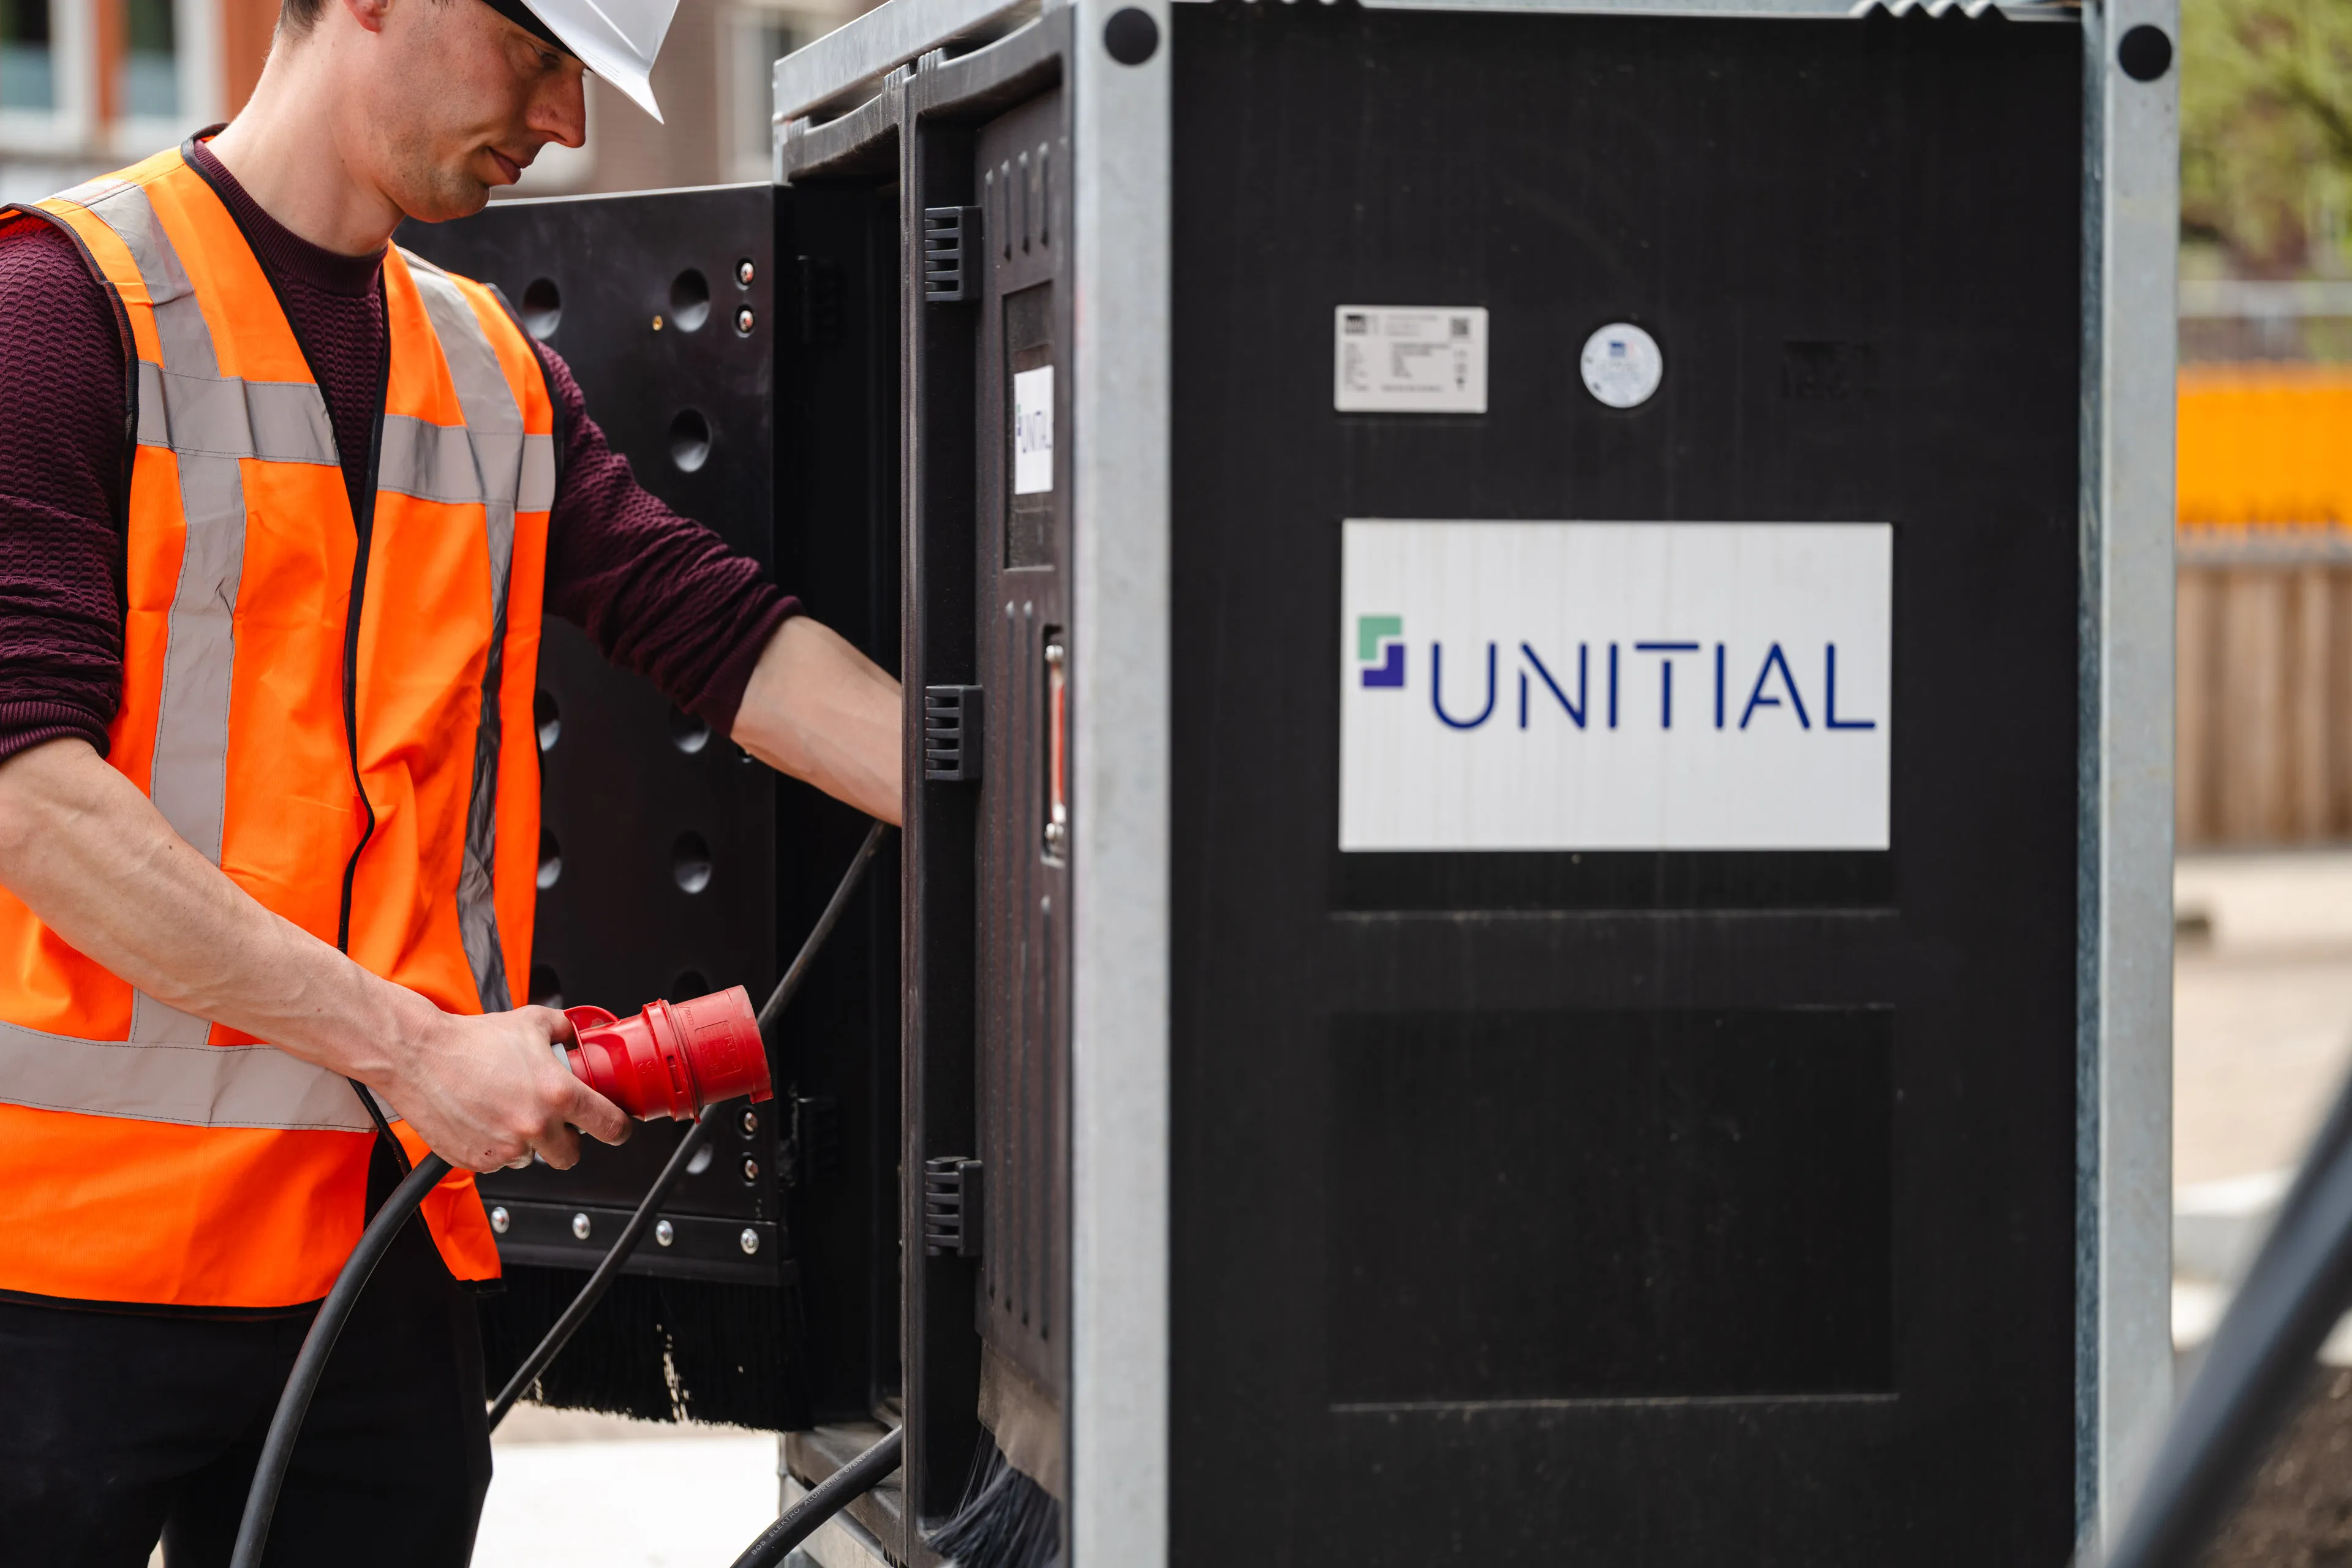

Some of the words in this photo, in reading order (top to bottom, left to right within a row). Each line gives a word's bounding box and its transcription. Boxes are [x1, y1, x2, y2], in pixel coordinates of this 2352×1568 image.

[1431, 640, 1876, 731] UNITIAL
[751, 1539, 766, 1556] BOS
[769, 1507, 800, 1537] ELEKTRO
[804, 1475, 842, 1506] ALUPRENE
